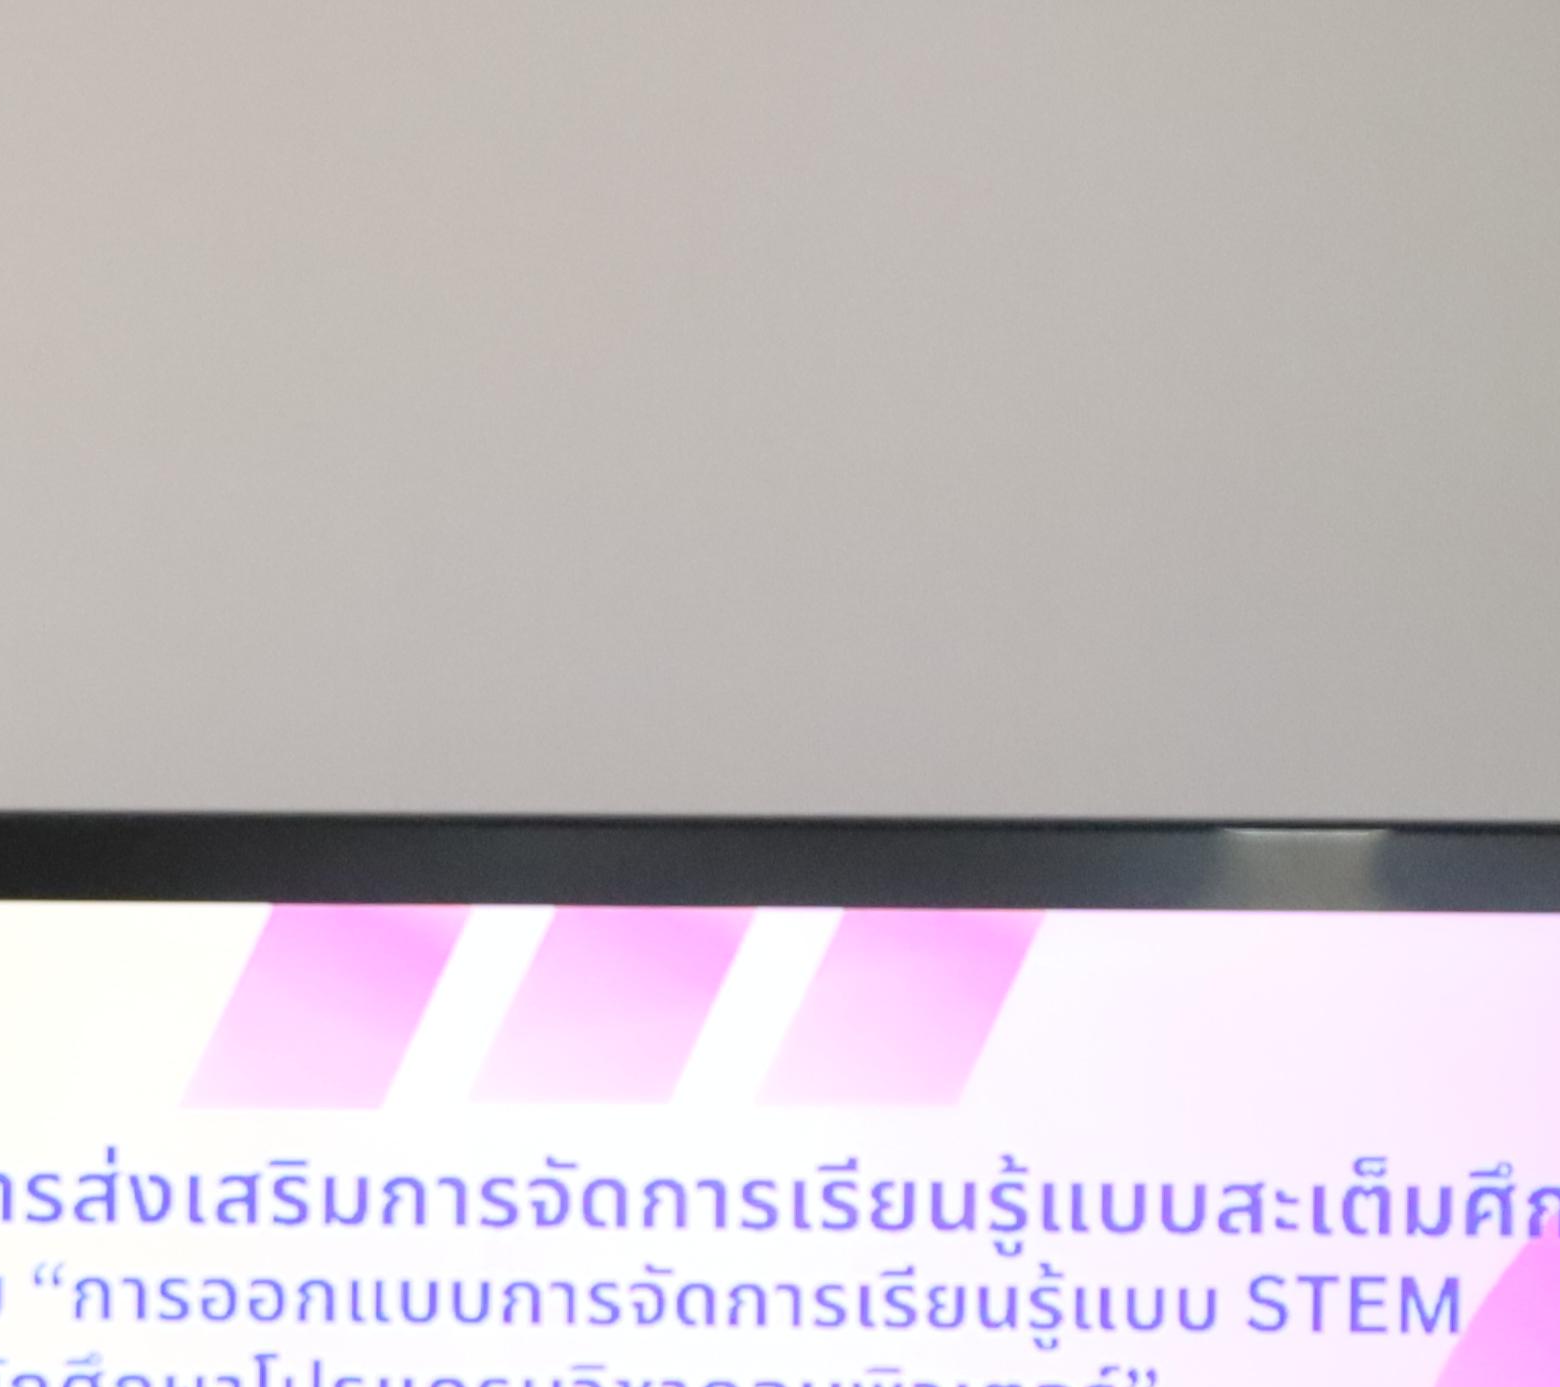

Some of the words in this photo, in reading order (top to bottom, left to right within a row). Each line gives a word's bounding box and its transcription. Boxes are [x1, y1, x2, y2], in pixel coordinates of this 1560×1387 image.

[32, 1260, 1219, 1350] “การออกแบบการจัดการเรียนรู้แบบ
[1246, 1273, 1462, 1335] STEM
